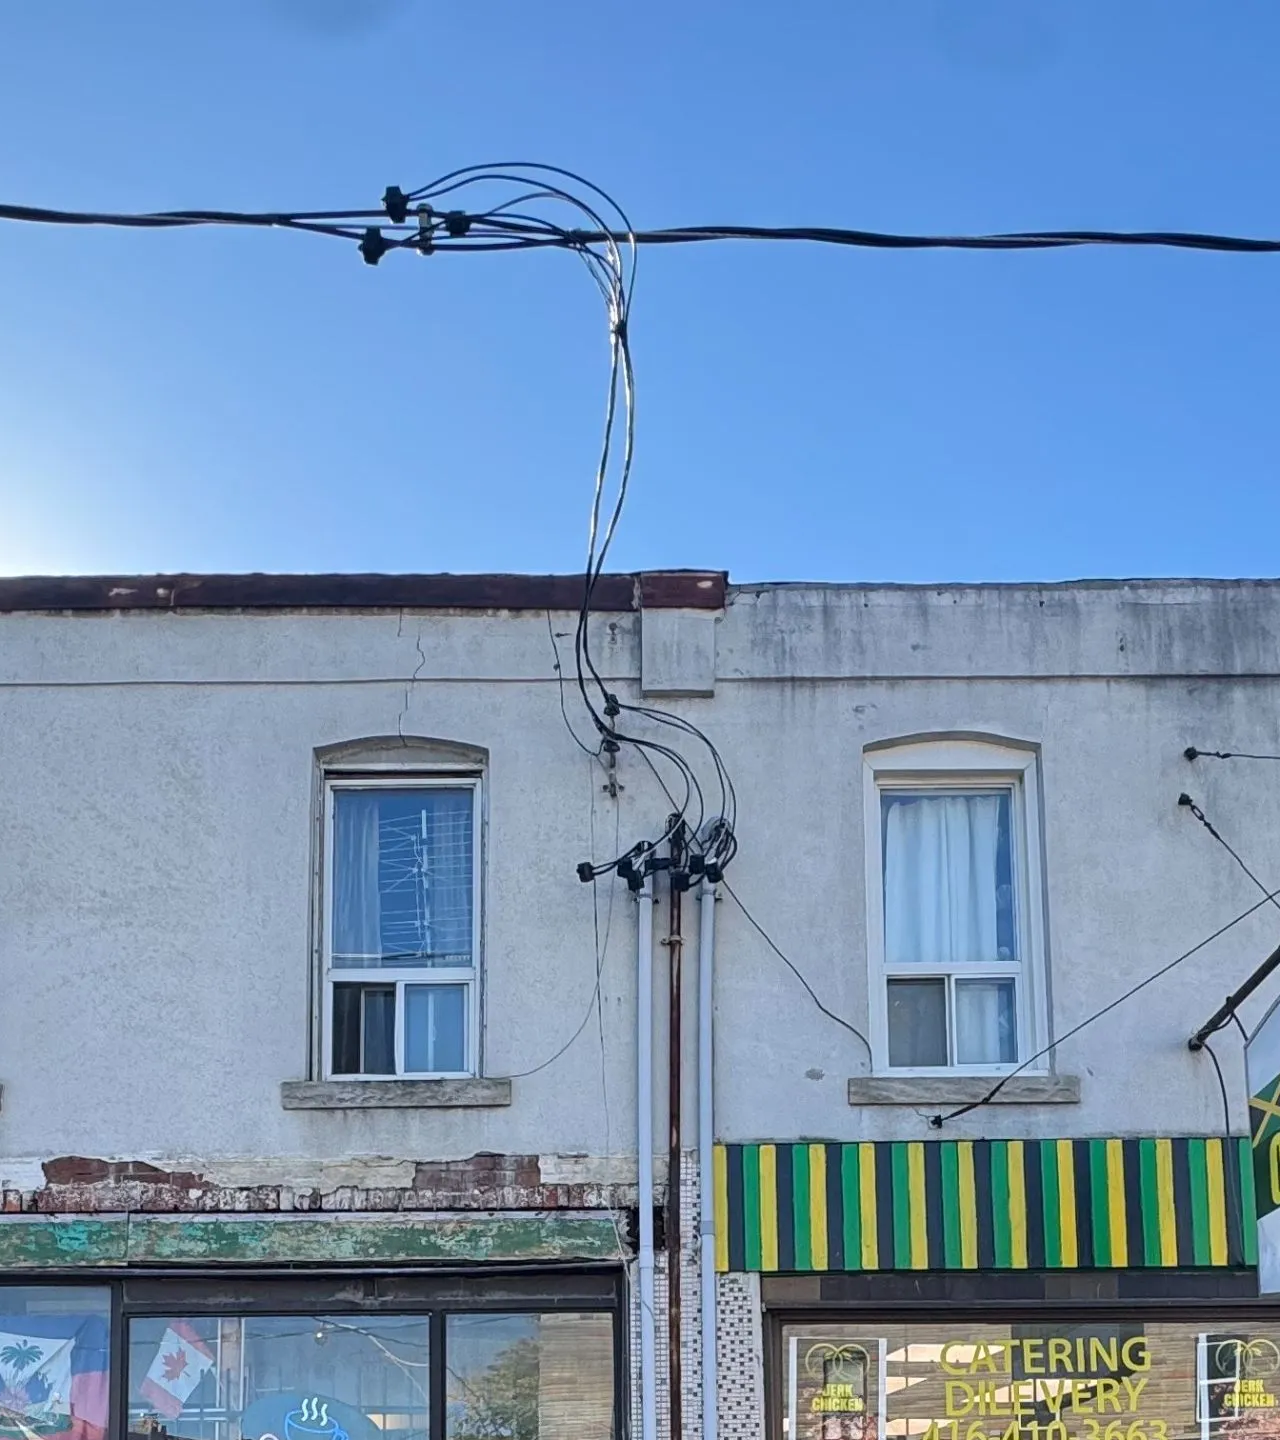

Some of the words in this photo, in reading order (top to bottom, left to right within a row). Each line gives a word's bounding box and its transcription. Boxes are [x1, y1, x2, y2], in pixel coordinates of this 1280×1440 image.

[939, 1336, 1152, 1376] CATERING
[821, 1383, 853, 1397] JERK
[944, 1378, 1149, 1418] DILEVERY
[811, 1397, 864, 1412] CHICKEN
